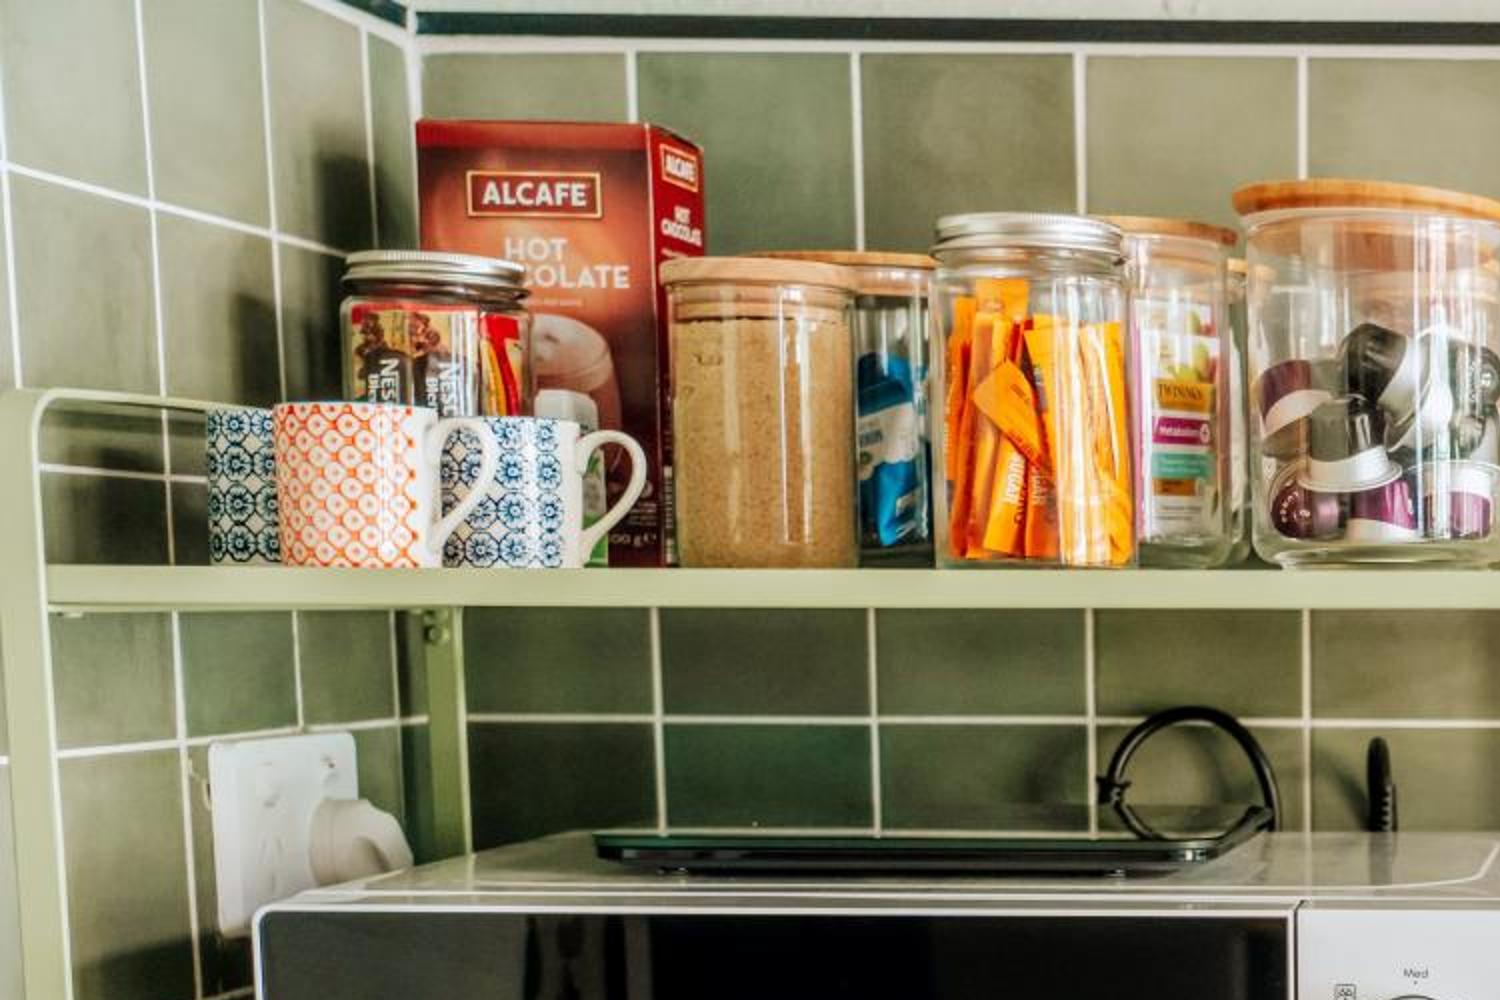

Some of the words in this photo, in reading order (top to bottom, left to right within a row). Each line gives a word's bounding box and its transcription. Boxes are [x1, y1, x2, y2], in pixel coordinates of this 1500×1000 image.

[482, 181, 588, 207] ALCAFE
[504, 237, 569, 261] HOT
[523, 264, 631, 289] COLATE
[1403, 968, 1429, 979] Med
